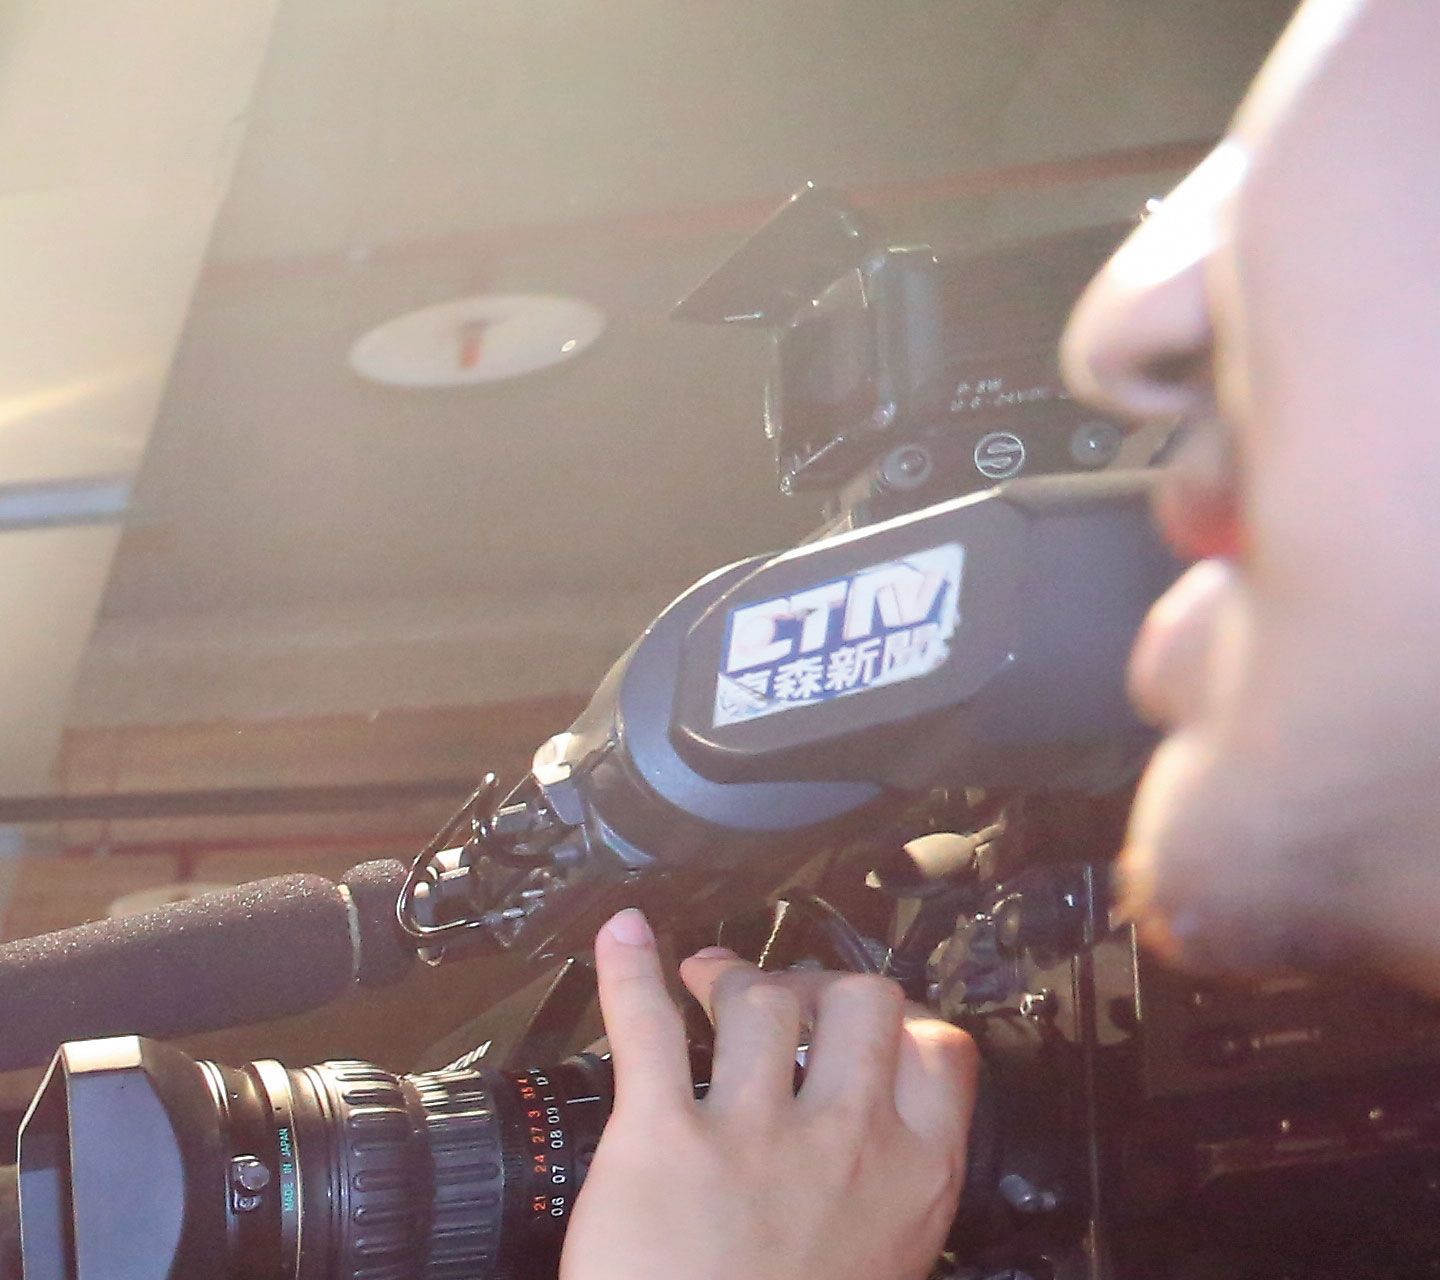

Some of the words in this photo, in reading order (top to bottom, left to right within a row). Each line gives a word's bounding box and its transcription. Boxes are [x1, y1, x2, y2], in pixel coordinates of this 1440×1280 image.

[279, 1128, 291, 1157] JAPAN
[283, 1163, 292, 1174] IN
[284, 1182, 294, 1211] MADE
